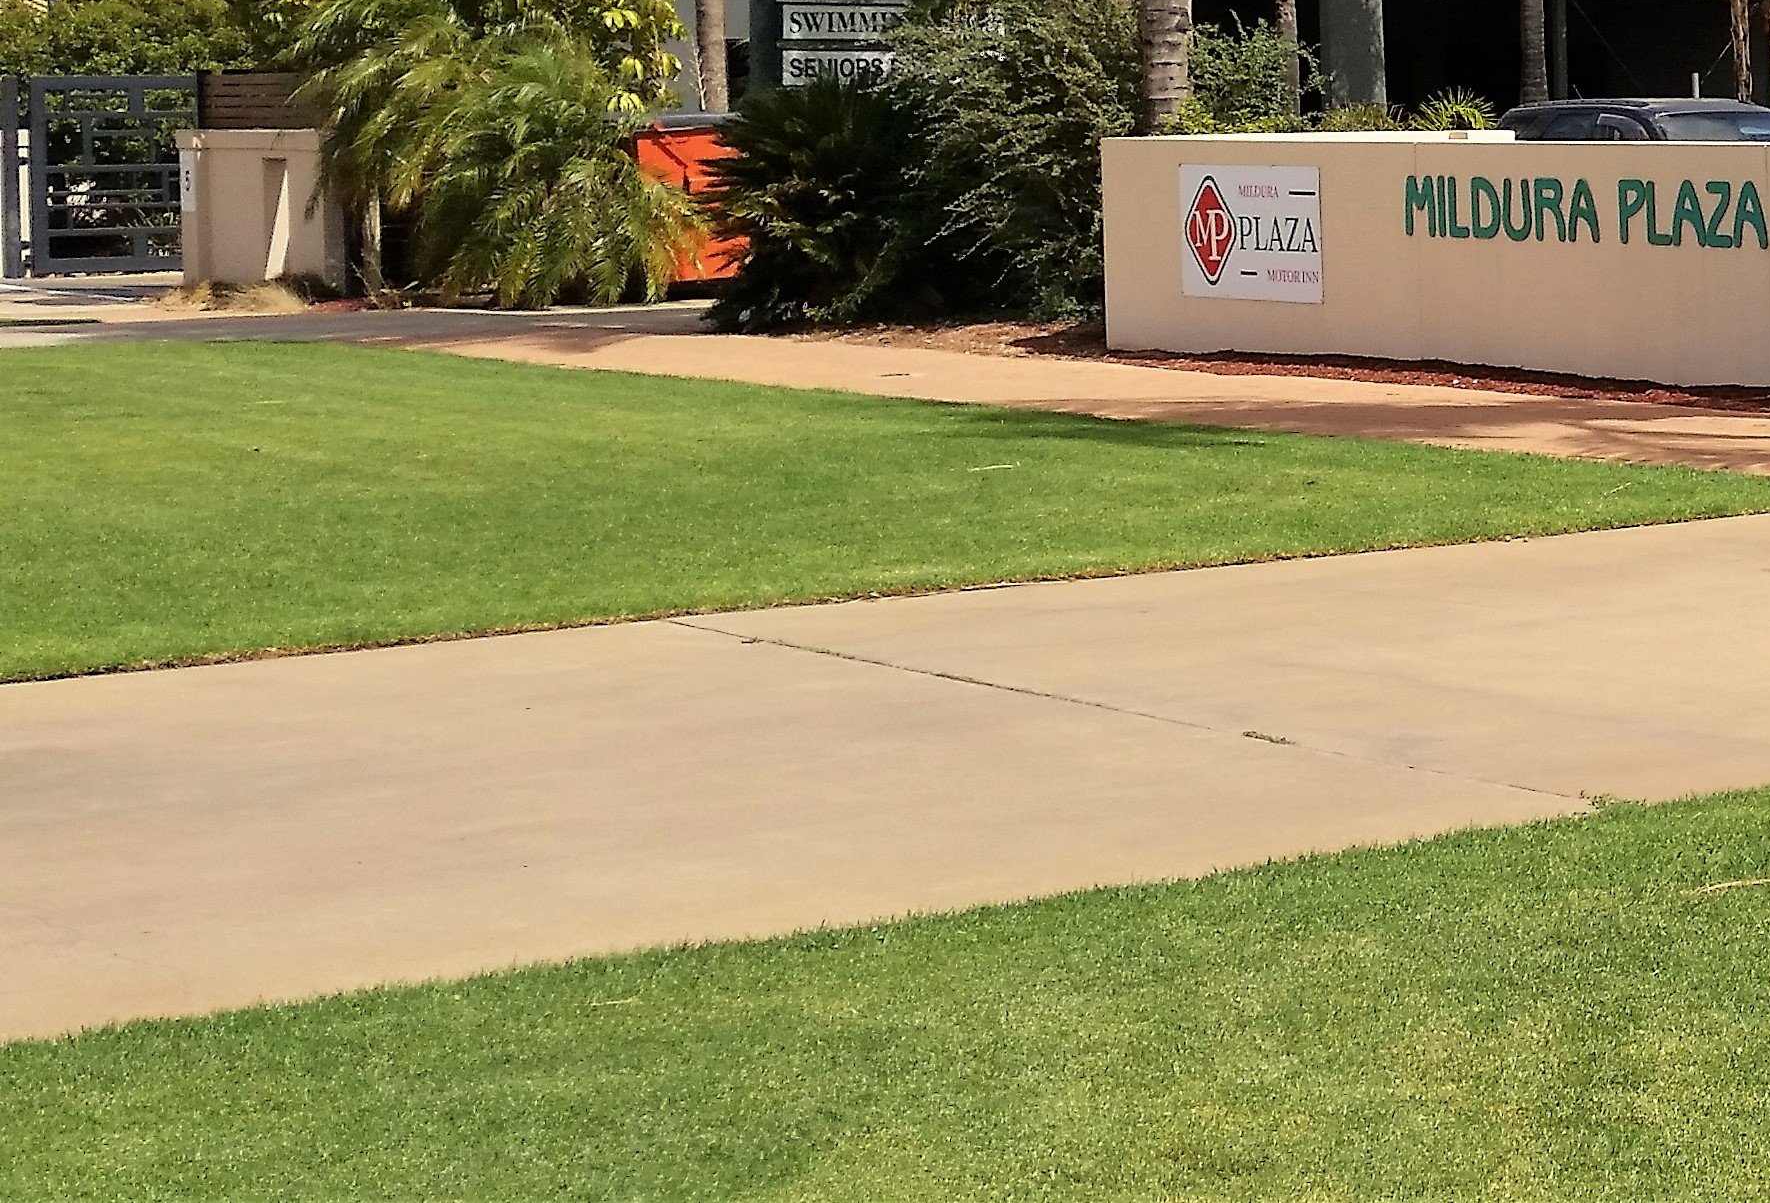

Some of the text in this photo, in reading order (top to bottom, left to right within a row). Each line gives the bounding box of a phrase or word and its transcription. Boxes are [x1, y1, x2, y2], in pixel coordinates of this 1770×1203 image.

[789, 58, 884, 78] SENIORS
[1238, 185, 1279, 198] MILDURA
[1405, 176, 1600, 242] MILDURA
[1618, 179, 1768, 249] PLAZA
[1238, 216, 1319, 253] PLAZA
[1267, 269, 1319, 283] MOTOR INN
